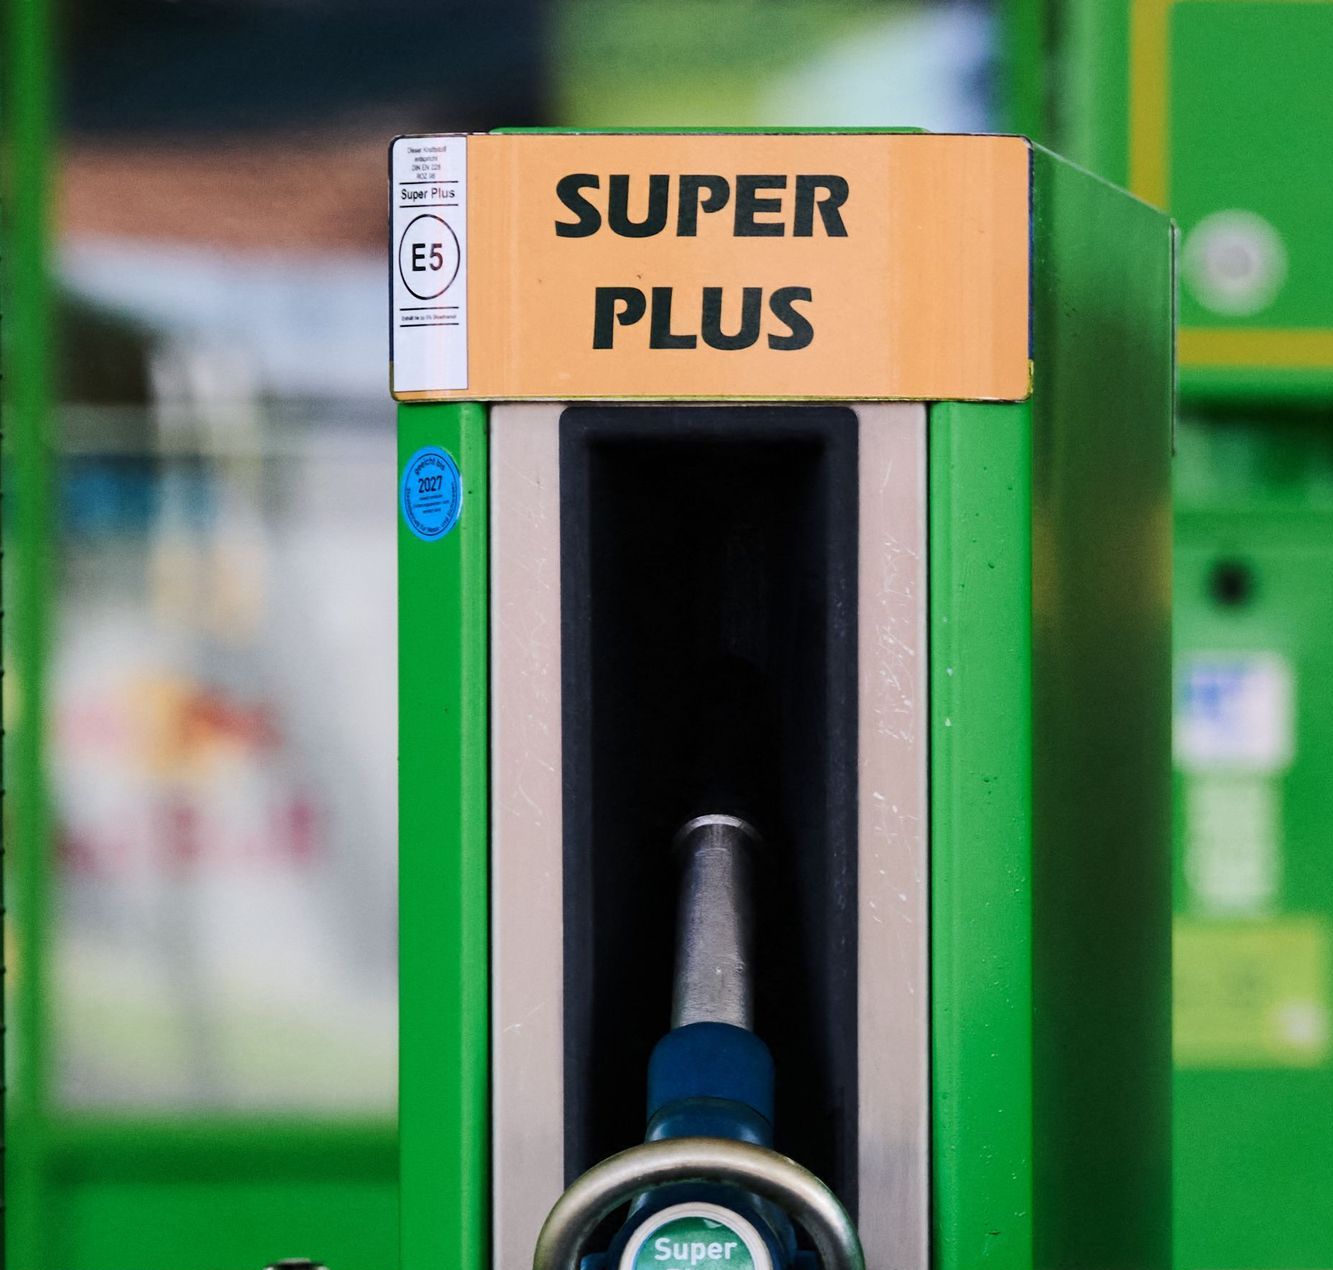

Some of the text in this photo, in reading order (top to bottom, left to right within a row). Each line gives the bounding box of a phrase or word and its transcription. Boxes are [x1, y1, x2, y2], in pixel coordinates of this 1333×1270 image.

[401, 187, 455, 202] Super Plus
[555, 173, 850, 238] SUPER
[412, 243, 443, 271] E5
[592, 286, 815, 351] PLUS
[418, 475, 442, 493] 2027
[654, 1237, 738, 1266] Super
